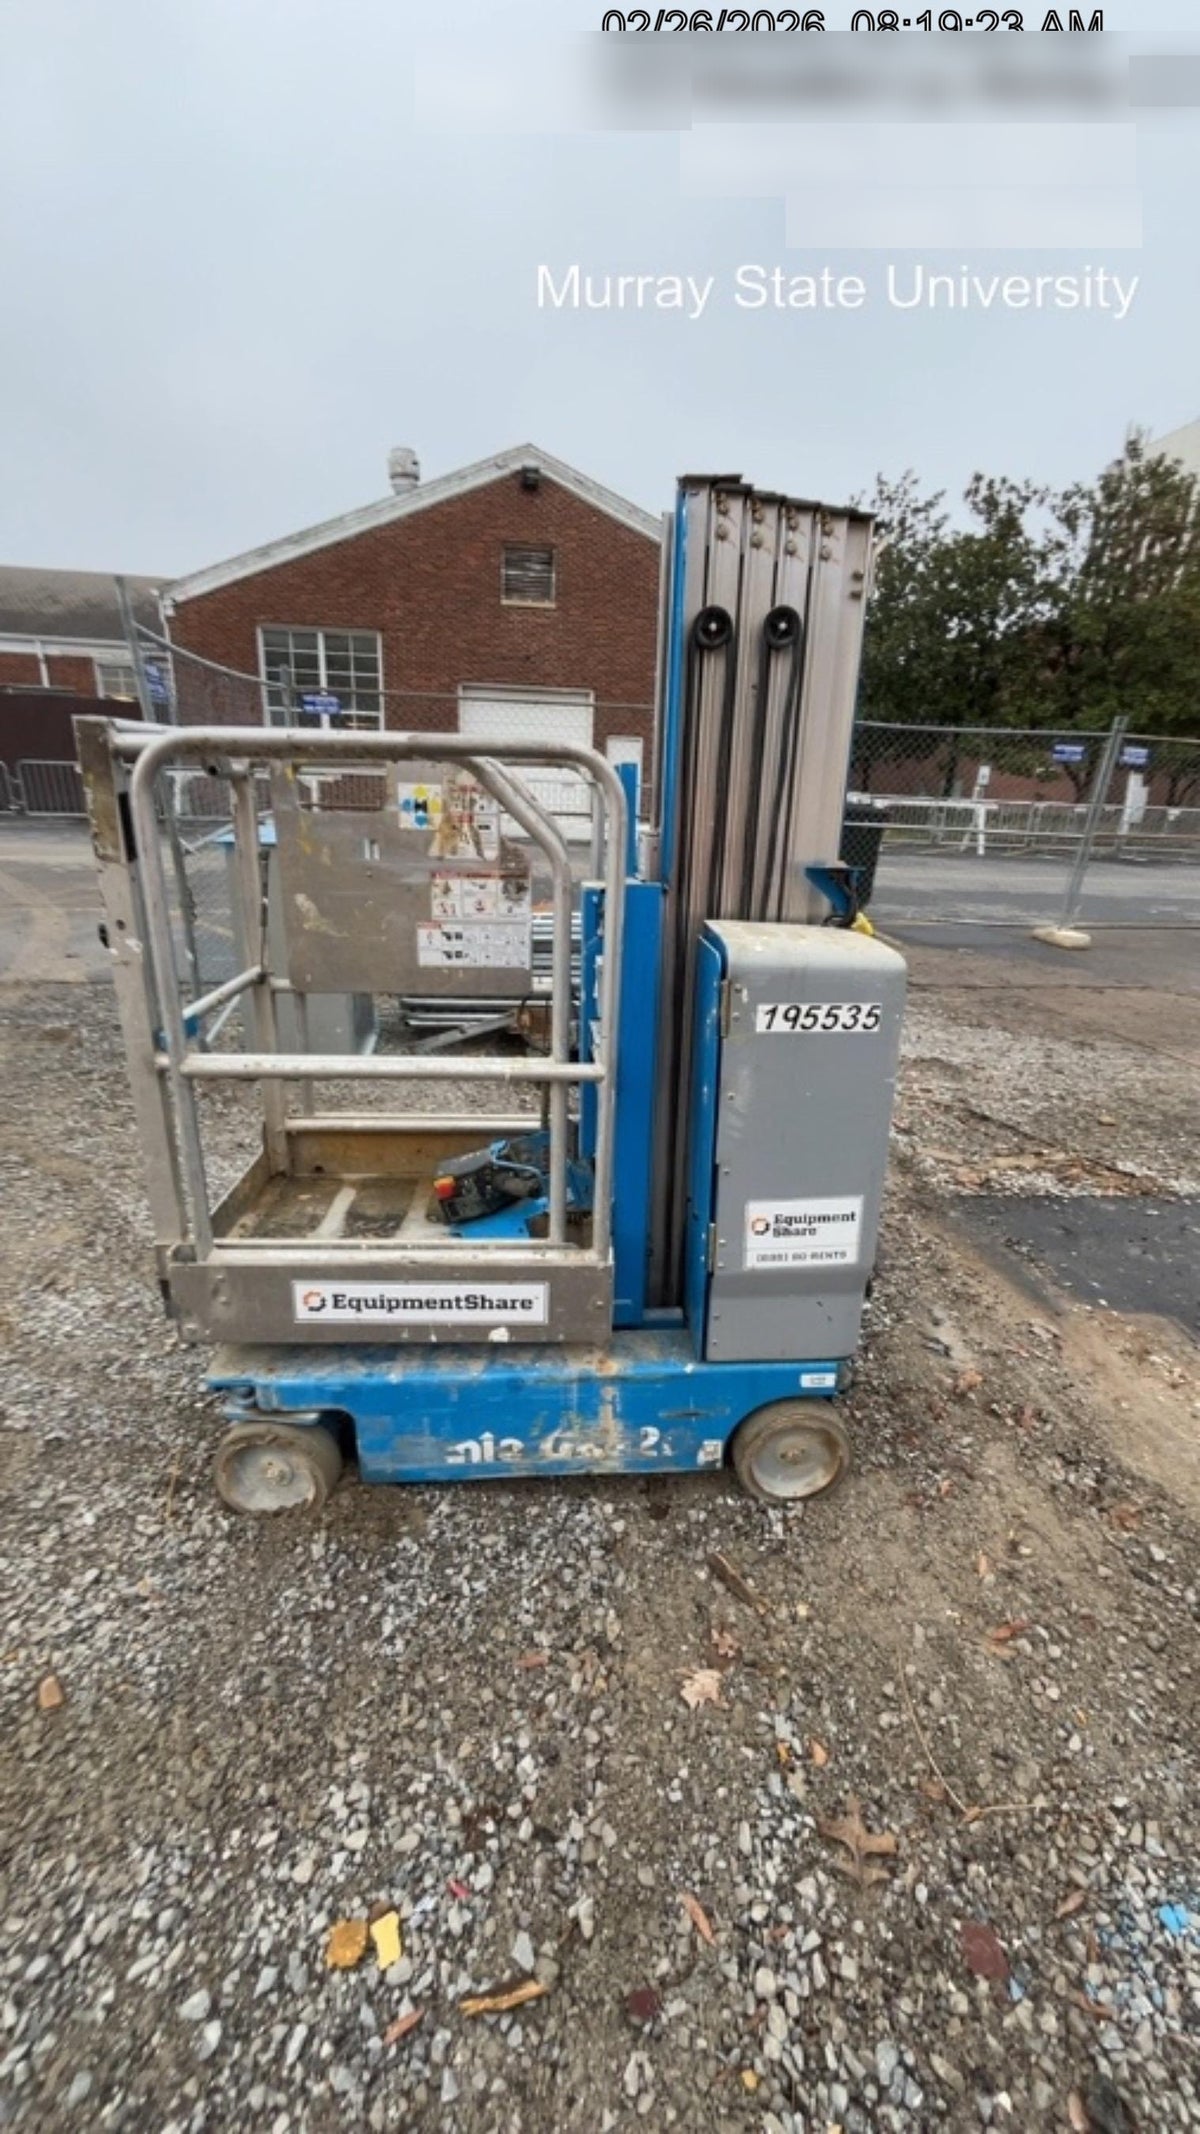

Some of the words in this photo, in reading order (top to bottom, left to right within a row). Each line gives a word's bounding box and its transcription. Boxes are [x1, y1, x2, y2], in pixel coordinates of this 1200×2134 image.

[765, 1004, 881, 1031] 195535
[773, 1211, 857, 1227] Equipment
[772, 1227, 817, 1238] Share
[331, 1293, 534, 1313] EquipmentShare
